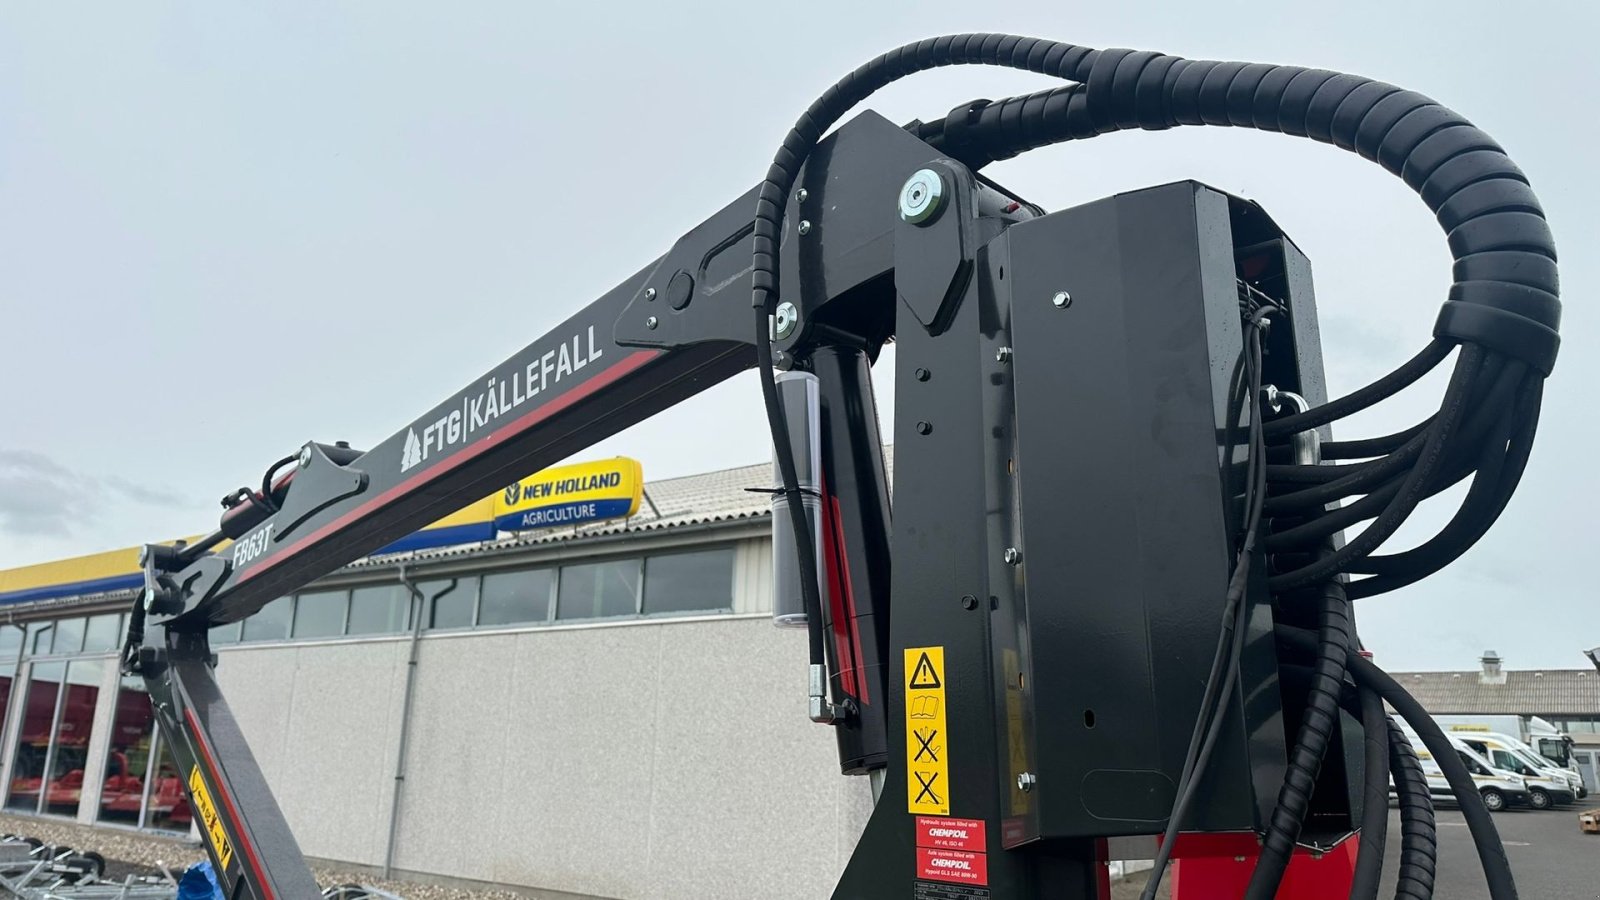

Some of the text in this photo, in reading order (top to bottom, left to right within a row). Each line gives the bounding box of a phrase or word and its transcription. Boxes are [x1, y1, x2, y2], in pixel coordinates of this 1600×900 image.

[423, 325, 603, 461] FTG KÄLLEFALL
[523, 472, 621, 500] NEW HOLLAND
[522, 503, 596, 526] AGRICULTURE
[231, 522, 274, 570] FB63T
[920, 818, 940, 826] Hydraulic
